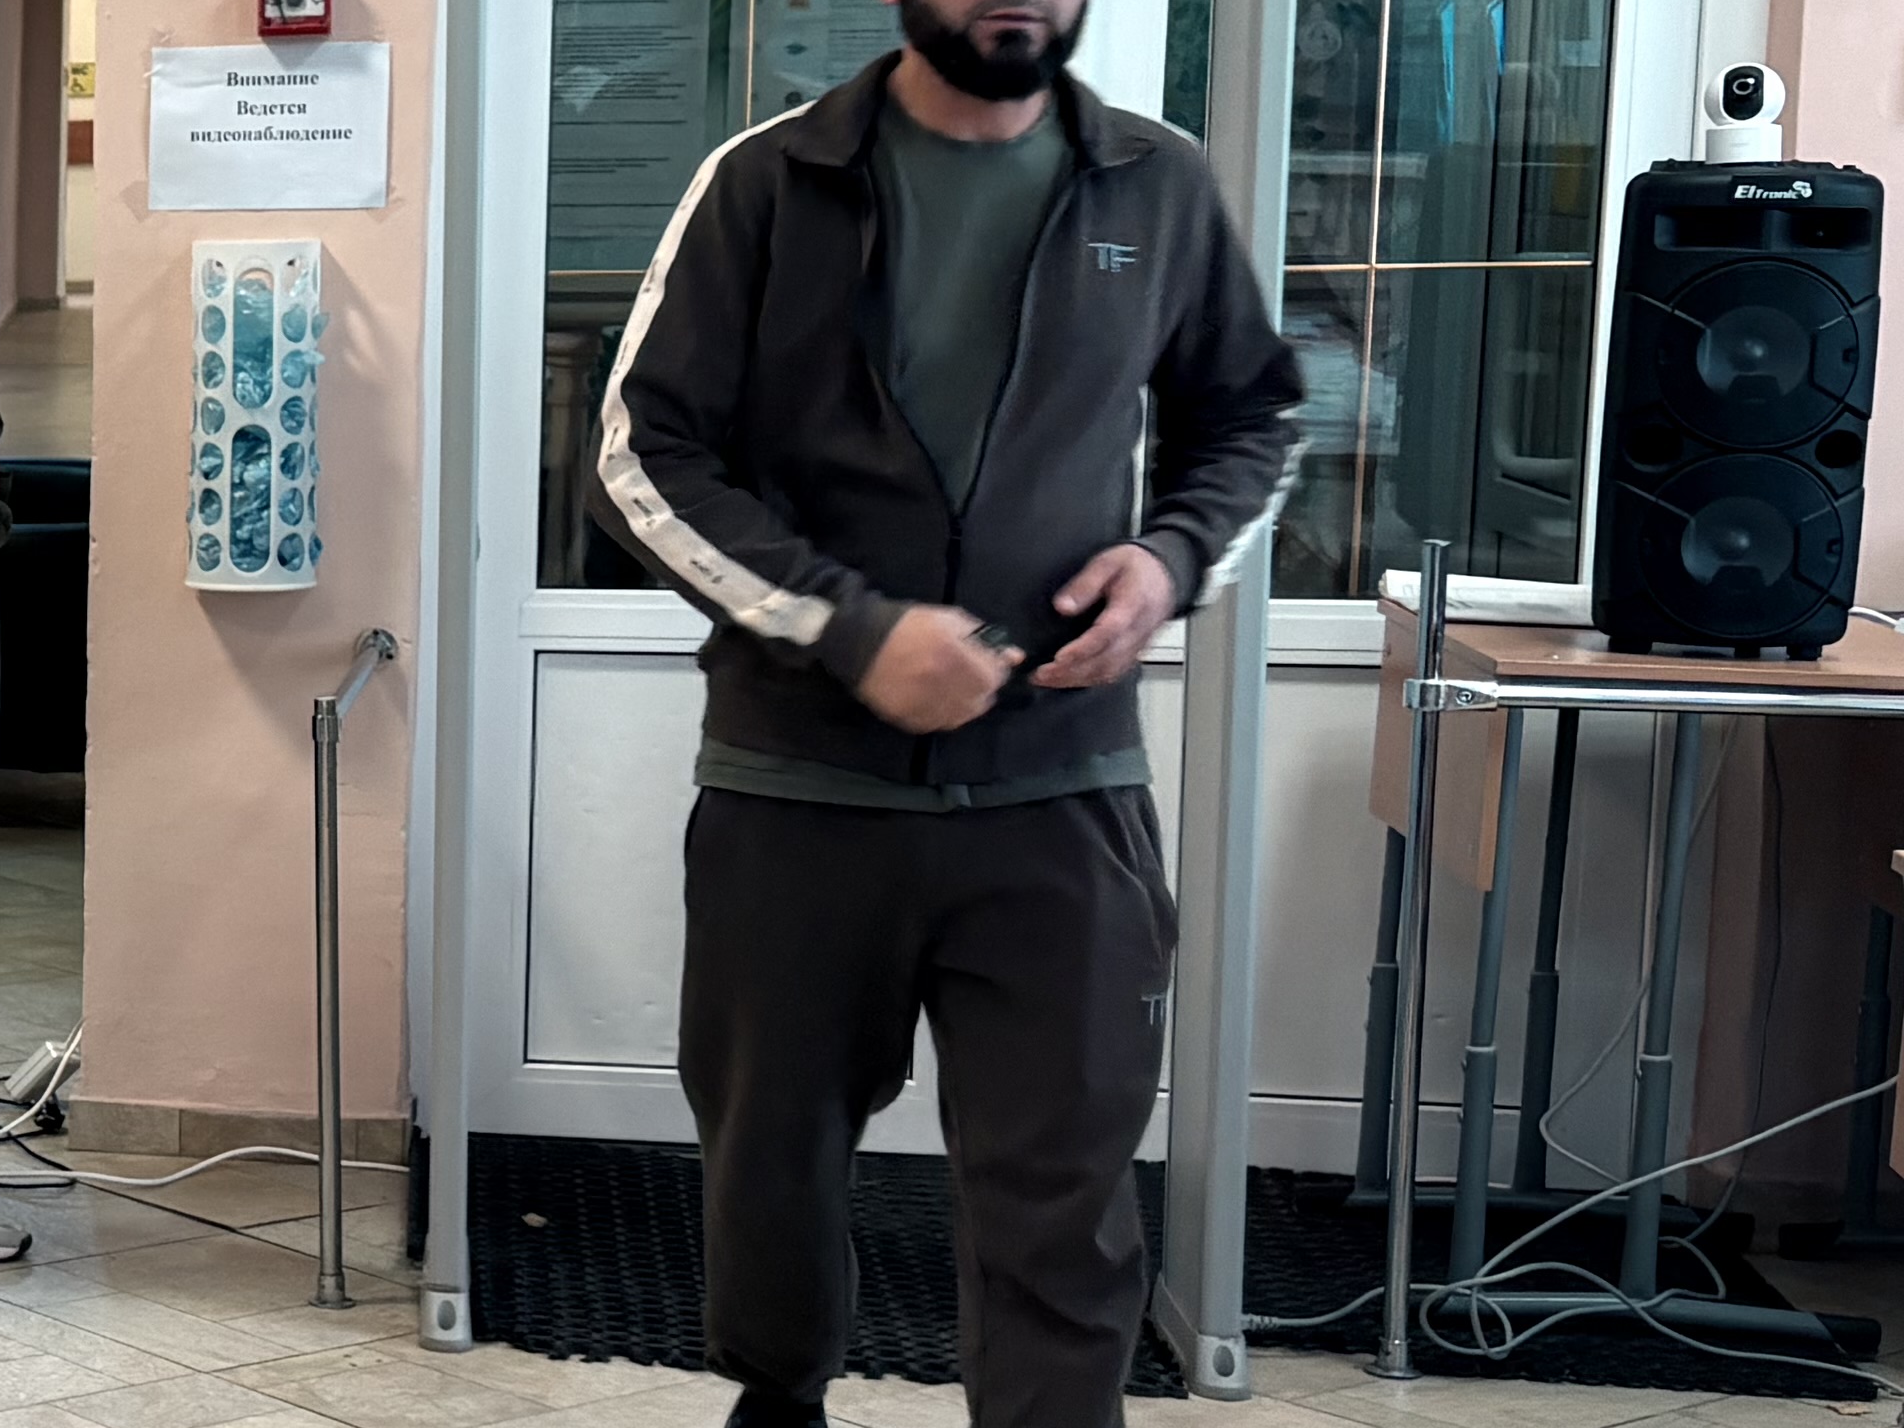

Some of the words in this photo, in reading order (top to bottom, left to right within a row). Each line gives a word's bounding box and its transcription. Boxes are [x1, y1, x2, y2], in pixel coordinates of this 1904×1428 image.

[226, 71, 320, 87] Внимание
[237, 100, 307, 116] Ведется
[190, 126, 353, 143] видеонаблюдение
